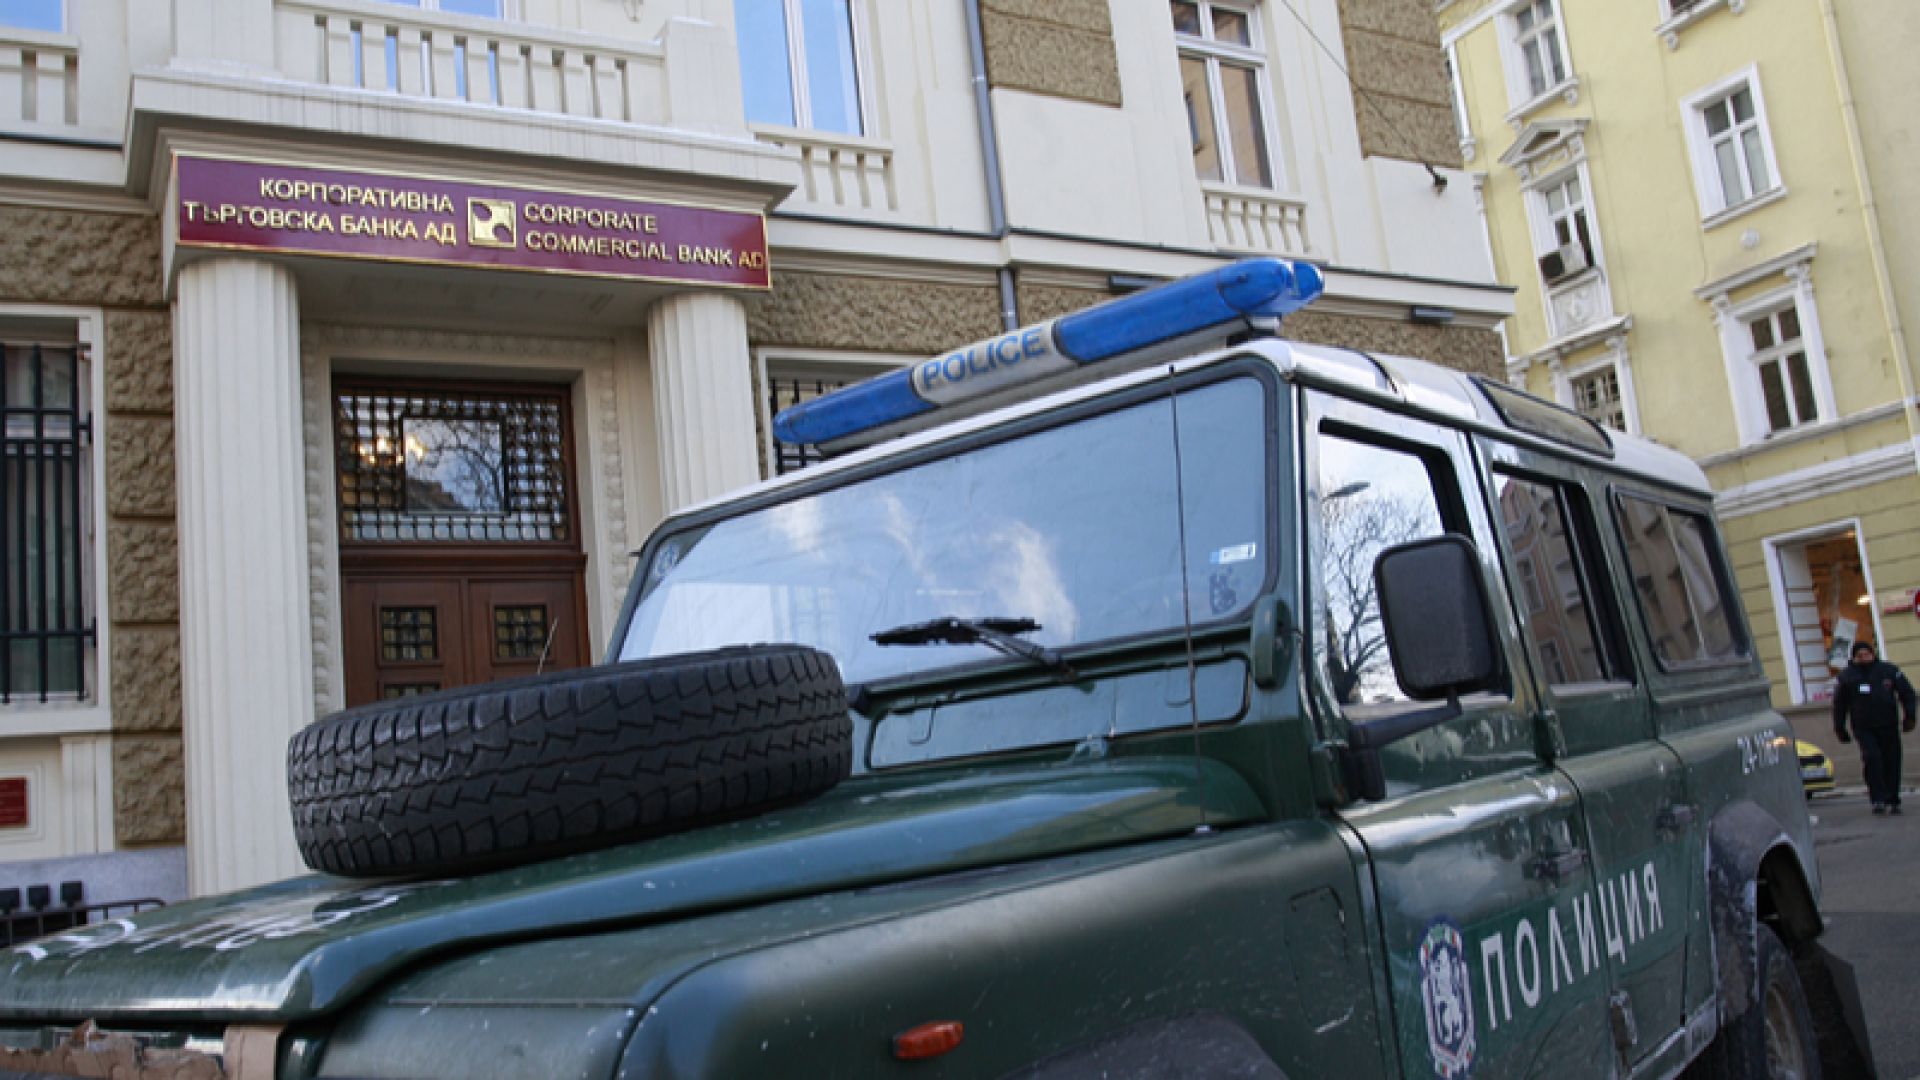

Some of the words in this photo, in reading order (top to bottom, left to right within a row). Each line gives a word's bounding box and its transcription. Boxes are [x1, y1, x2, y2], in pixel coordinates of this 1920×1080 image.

[259, 177, 454, 212] КОРПОРАТИВНА
[340, 215, 418, 241] БАНКА
[424, 222, 456, 246] АД
[523, 202, 658, 234] CORPORATE
[524, 229, 672, 261] COMMERCIAL
[678, 244, 733, 266] BANK
[738, 250, 766, 270] AD
[923, 328, 1046, 389] POLICE
[1480, 862, 1664, 1030] ПОЛИЦИЯ
